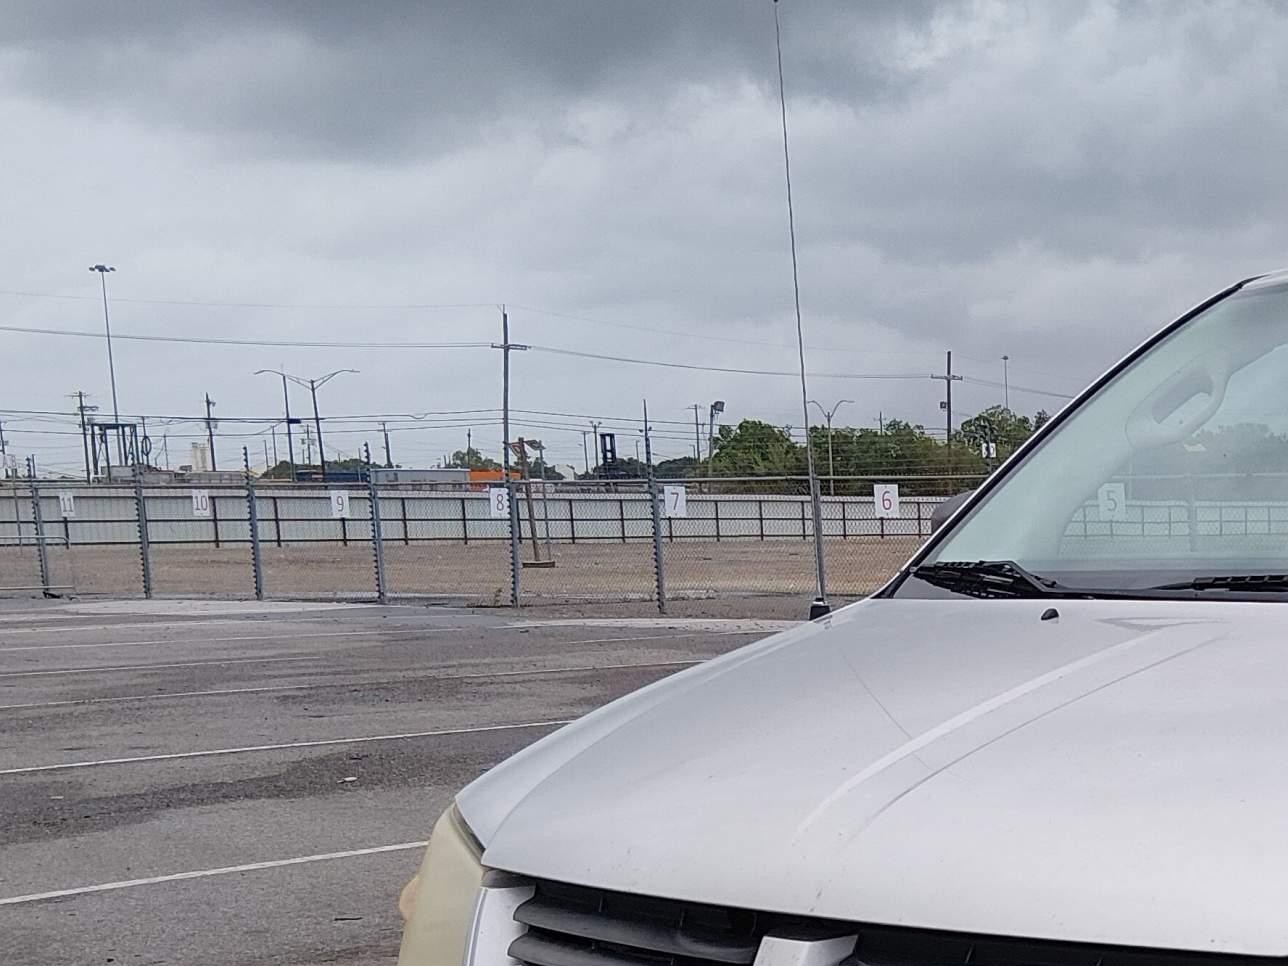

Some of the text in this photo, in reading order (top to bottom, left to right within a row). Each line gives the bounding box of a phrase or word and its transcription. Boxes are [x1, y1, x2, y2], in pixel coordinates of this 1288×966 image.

[61, 494, 75, 513] 11
[193, 494, 209, 512] 10
[336, 494, 345, 512] 9
[495, 492, 505, 512] 8
[670, 492, 680, 511] 7
[881, 490, 893, 511] 6
[1106, 489, 1118, 512] 5
